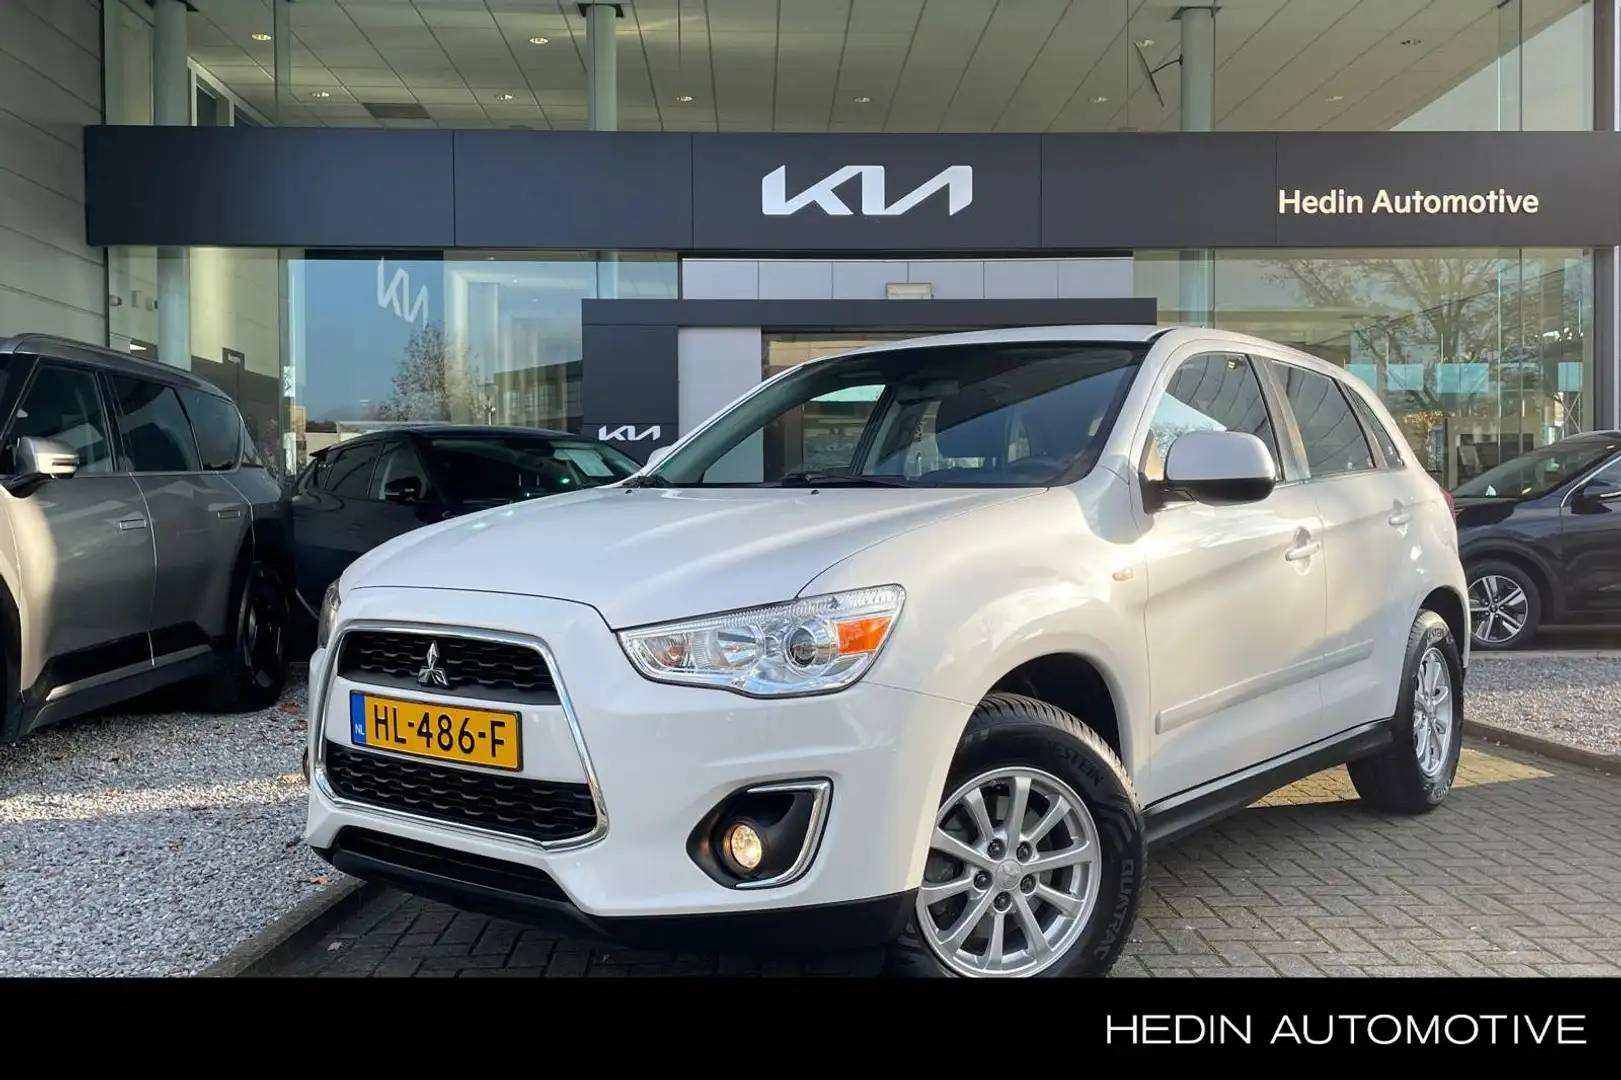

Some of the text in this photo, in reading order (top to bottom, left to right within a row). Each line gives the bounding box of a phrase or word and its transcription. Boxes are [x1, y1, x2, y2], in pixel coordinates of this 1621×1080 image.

[1278, 188, 1540, 215] Hedin Automotive
[355, 723, 365, 736] NL
[374, 704, 506, 758] HL-486-F
